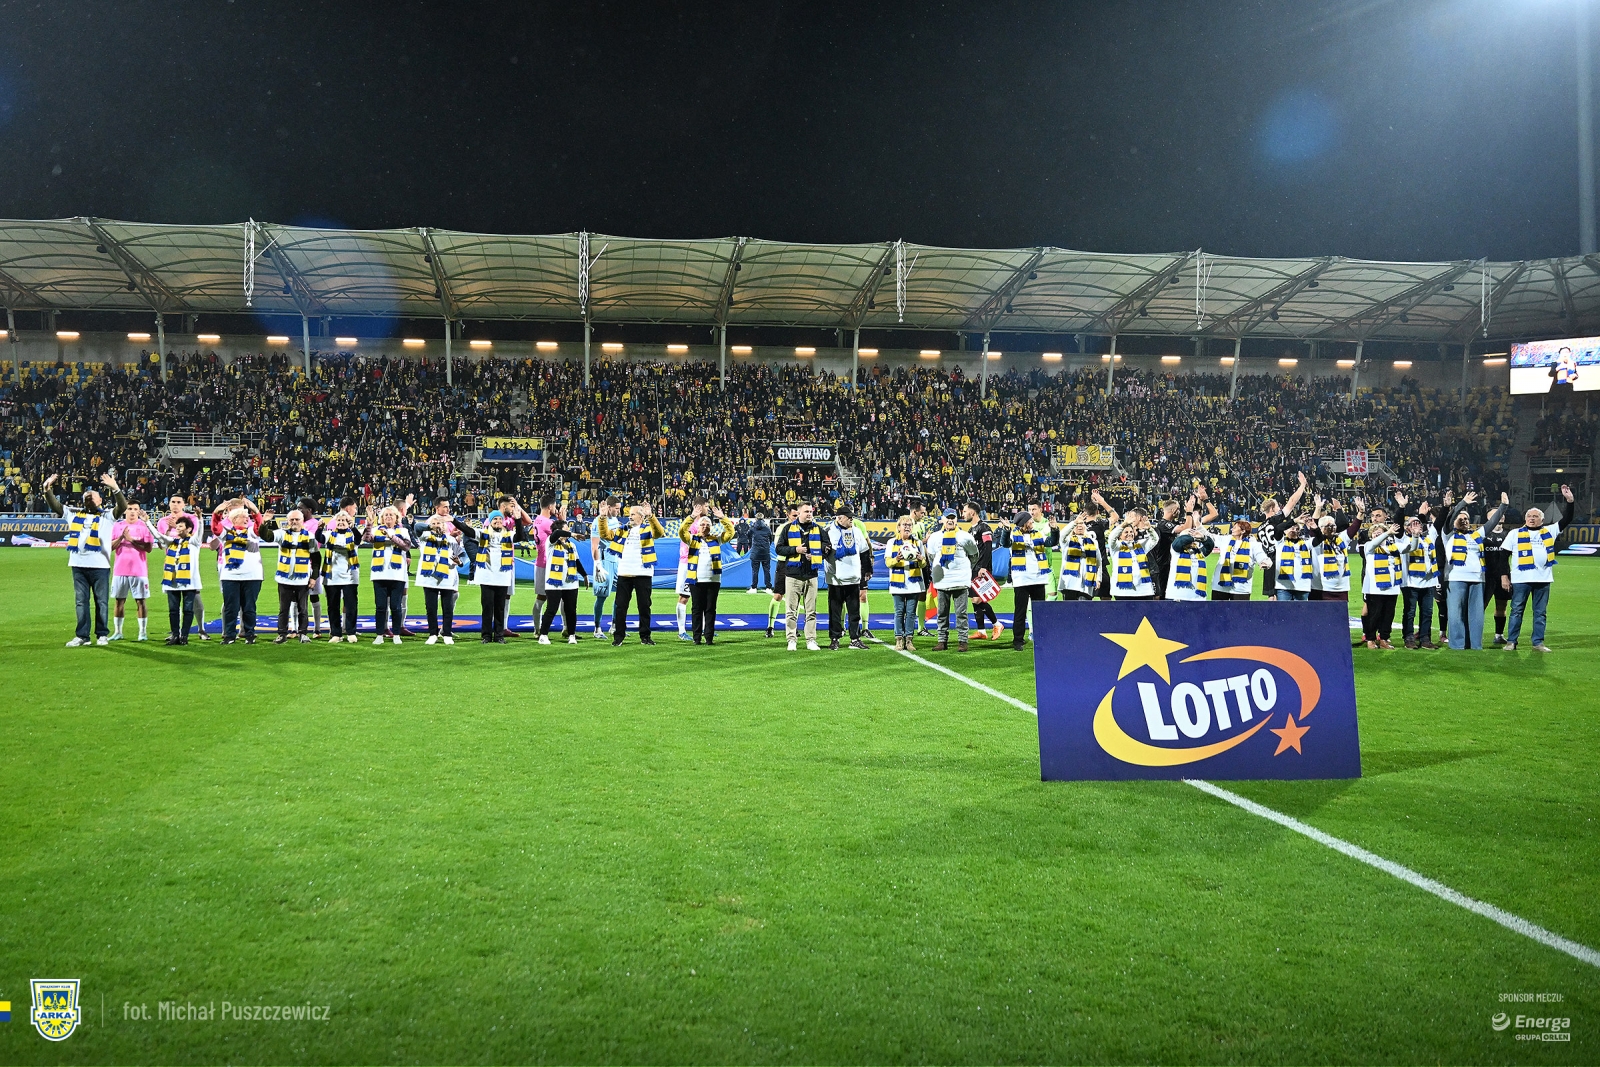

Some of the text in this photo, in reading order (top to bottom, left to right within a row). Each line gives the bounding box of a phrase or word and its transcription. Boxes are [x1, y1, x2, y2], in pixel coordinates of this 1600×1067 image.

[777, 447, 831, 460] GNIEWINO
[0, 523, 20, 532] RKA
[22, 523, 58, 532] ZNACZY
[1137, 668, 1278, 740] LOTTO
